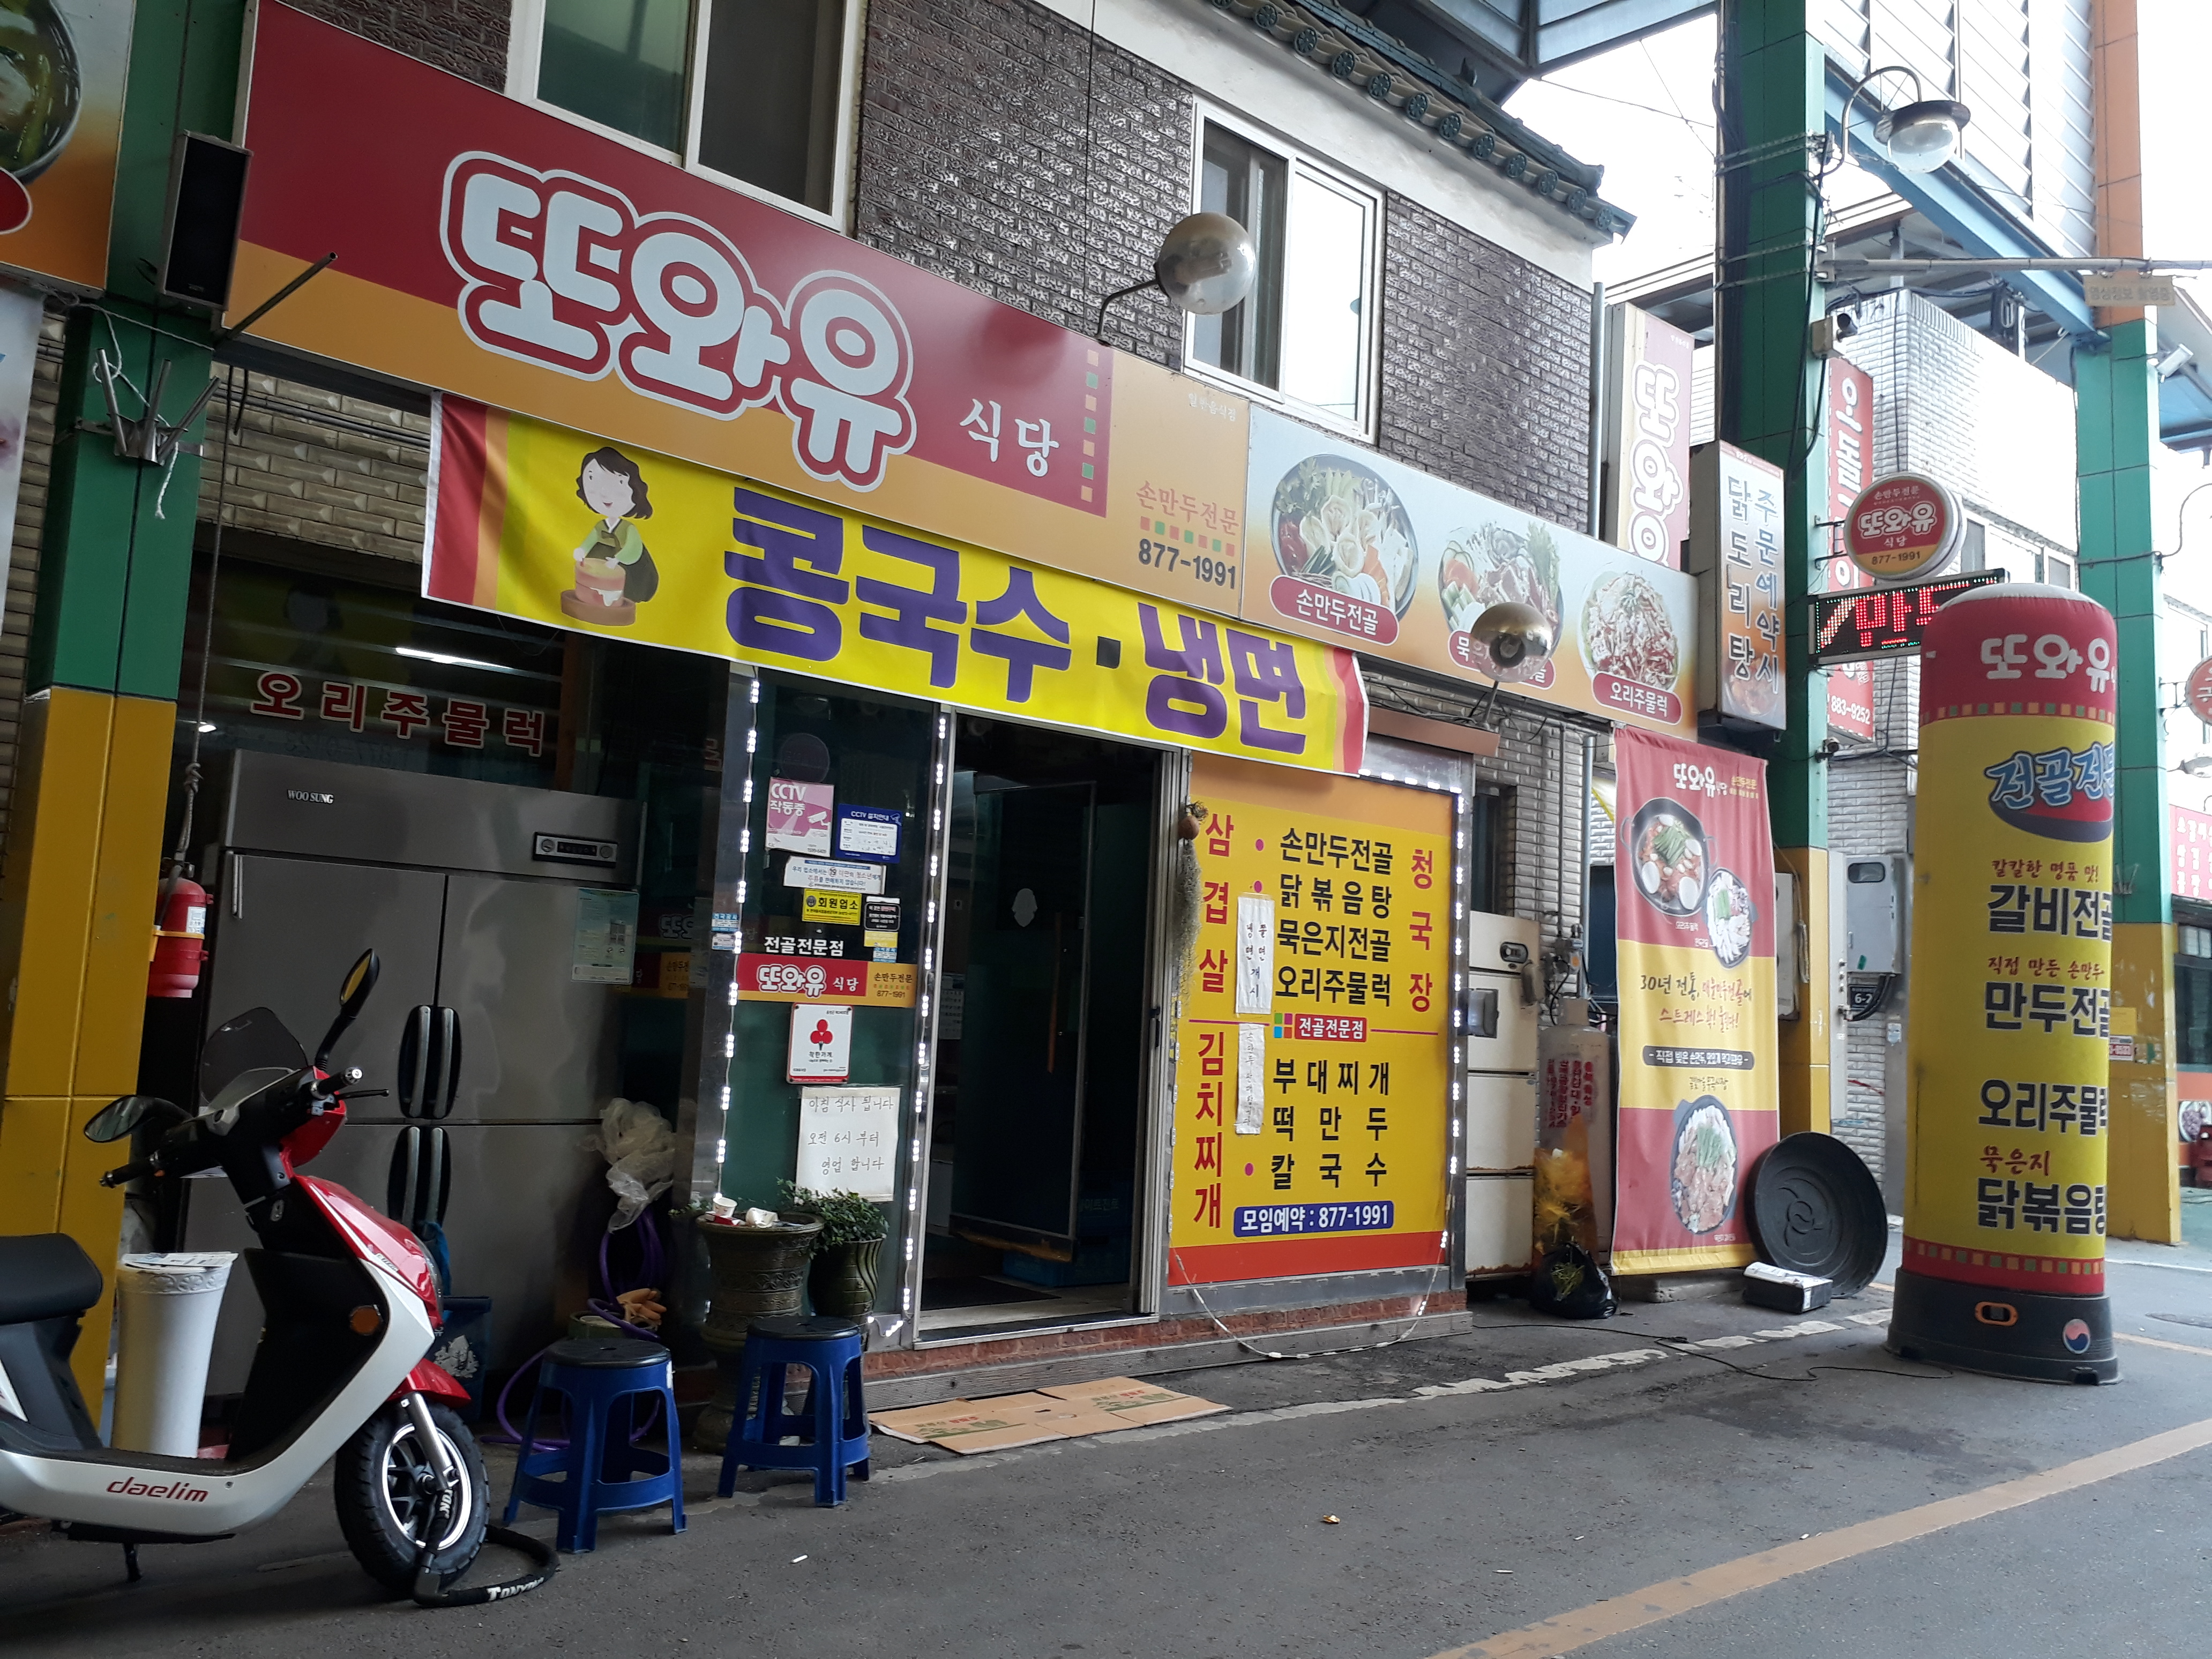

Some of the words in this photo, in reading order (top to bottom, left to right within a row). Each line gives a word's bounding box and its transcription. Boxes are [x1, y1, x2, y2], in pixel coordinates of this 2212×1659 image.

[454, 167, 908, 480] 또와유
[959, 398, 1060, 477] 식당
[1135, 480, 1239, 536] 손만두전문
[1859, 502, 1935, 536] 또와유
[1138, 537, 1237, 590] 877-1991
[1871, 550, 1921, 565] 877-1991
[1726, 475, 1755, 682] 닭도리탕
[1754, 489, 1781, 693] 주문예약시
[1295, 588, 1379, 637] 손만두전골
[1980, 633, 2111, 693] 또와유
[250, 670, 545, 757] 오리주물럭
[1609, 682, 1669, 718] 오리주물럭
[771, 783, 806, 801] CCTV
[1672, 763, 1716, 798] 또와유
[769, 799, 806, 817] 작동중
[850, 810, 867, 818] CCTV
[1279, 827, 1394, 876] 손만두전골
[1992, 858, 2043, 879] 칼칼한
[2050, 861, 2079, 881] 명품
[818, 897, 858, 910] 회원업소
[1199, 812, 1235, 994] 삼겹살
[764, 936, 844, 957] 전골전문점
[1276, 919, 1391, 963] 묵은지전골
[1409, 848, 1433, 1013] 청국장
[759, 965, 826, 998] 또와유
[832, 977, 859, 992] 식당
[873, 972, 913, 983] 손만두전문
[1640, 974, 1672, 995] 30년
[1987, 955, 2020, 976] 직접
[2028, 957, 2060, 980] 만든
[2067, 960, 2105, 982] 손만두
[876, 990, 906, 998] 877-1991
[1275, 966, 1391, 1007] 오리주물럭
[1298, 1017, 1364, 1040] 전골전문점
[809, 1096, 829, 1113] 아침
[834, 1096, 857, 1113] 식사
[1193, 1031, 1225, 1229] 김치찌개
[821, 1156, 841, 1176] 영업
[1979, 1145, 2051, 1176] 묵은지
[107, 1476, 209, 1503] daelim
